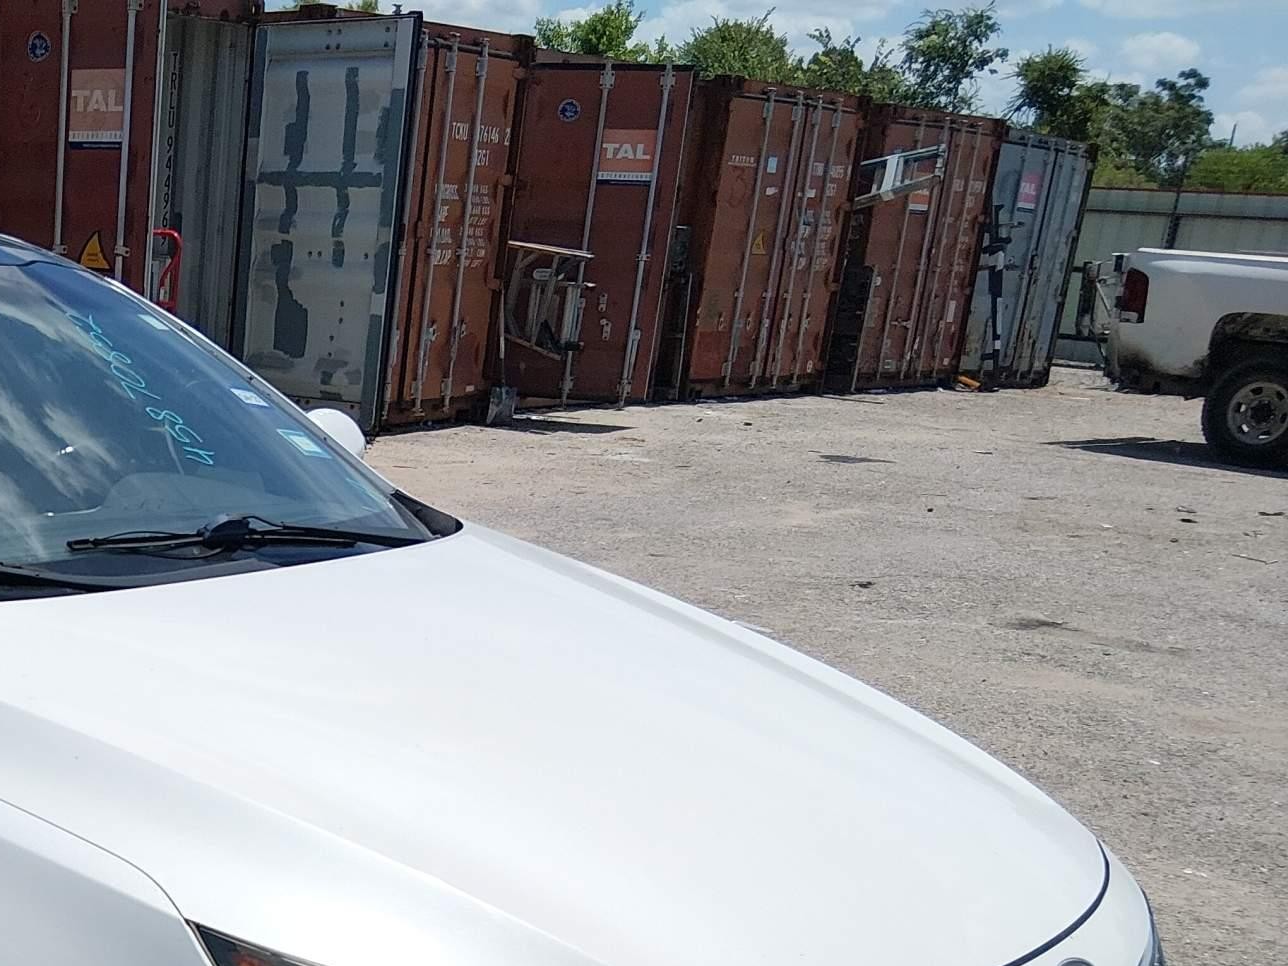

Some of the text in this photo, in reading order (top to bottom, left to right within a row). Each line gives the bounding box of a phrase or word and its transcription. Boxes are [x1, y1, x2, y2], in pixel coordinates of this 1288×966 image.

[71, 88, 124, 113] TAL
[168, 52, 179, 128] TRLU
[602, 143, 651, 160] TAL
